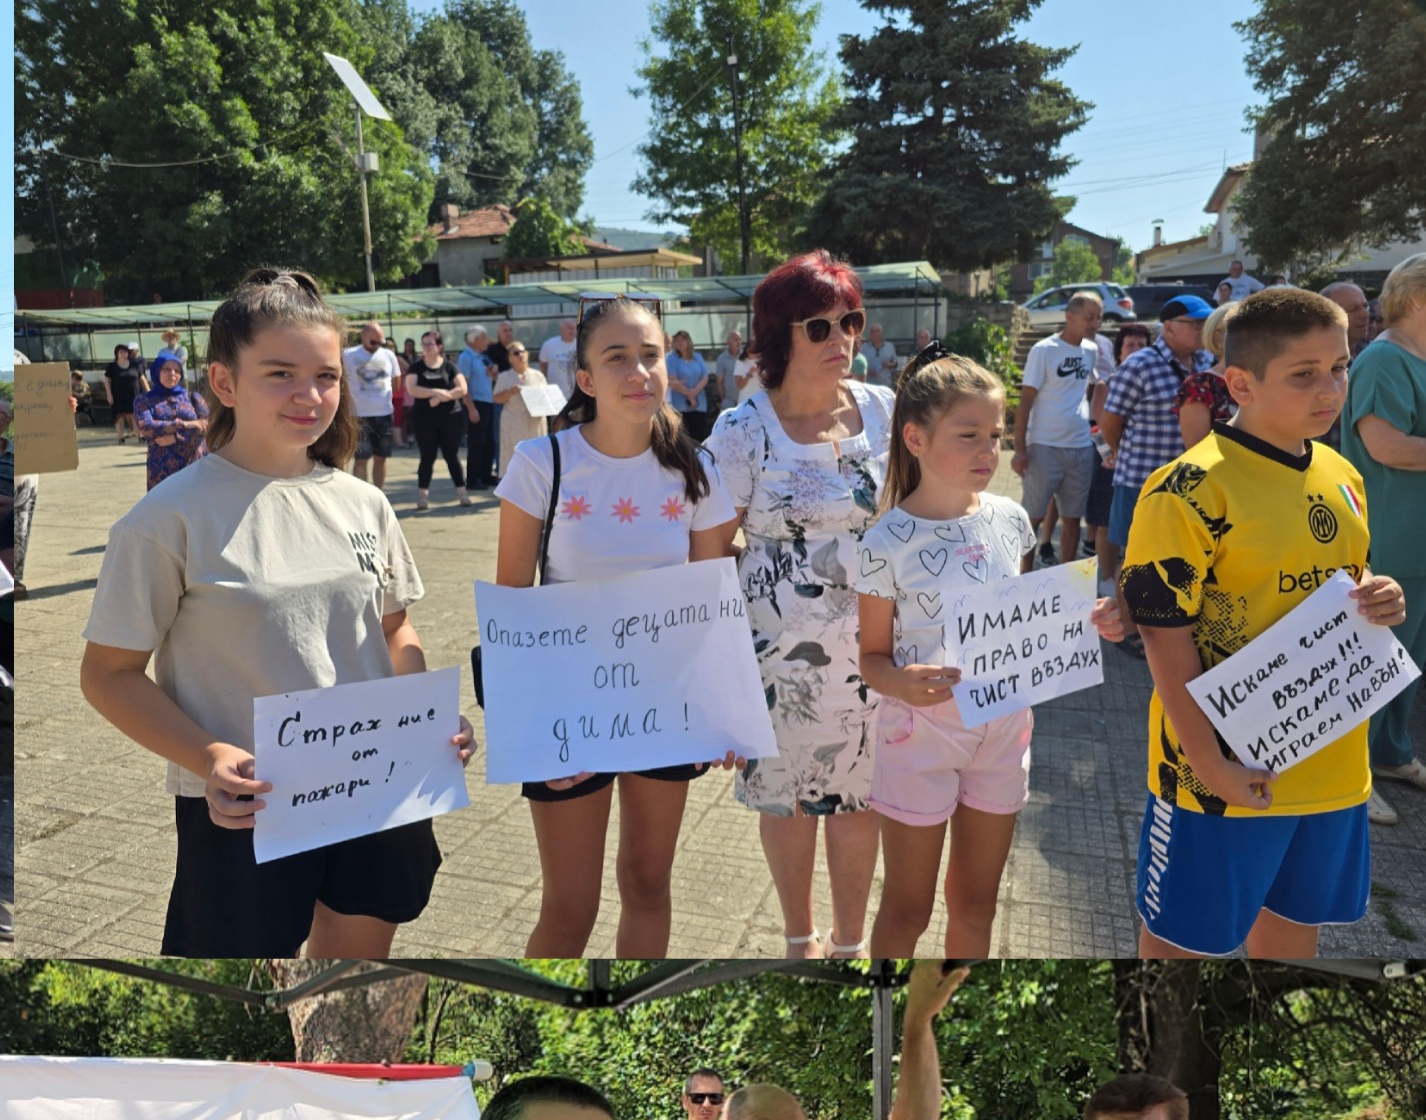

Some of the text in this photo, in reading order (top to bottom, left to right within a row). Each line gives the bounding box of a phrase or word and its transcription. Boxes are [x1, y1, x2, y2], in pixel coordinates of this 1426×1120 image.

[487, 618, 588, 648] Опазете
[612, 603, 711, 649] децата
[957, 595, 1061, 645] ИМАМЕ
[974, 620, 1083, 676] ПРАВО НА
[594, 661, 640, 689] от
[969, 648, 1100, 708] ЧИСТ ВЪЗДУХ
[277, 708, 436, 747] Страх ние
[553, 707, 662, 763] дима
[351, 747, 379, 761] от
[291, 778, 372, 807] пожари
